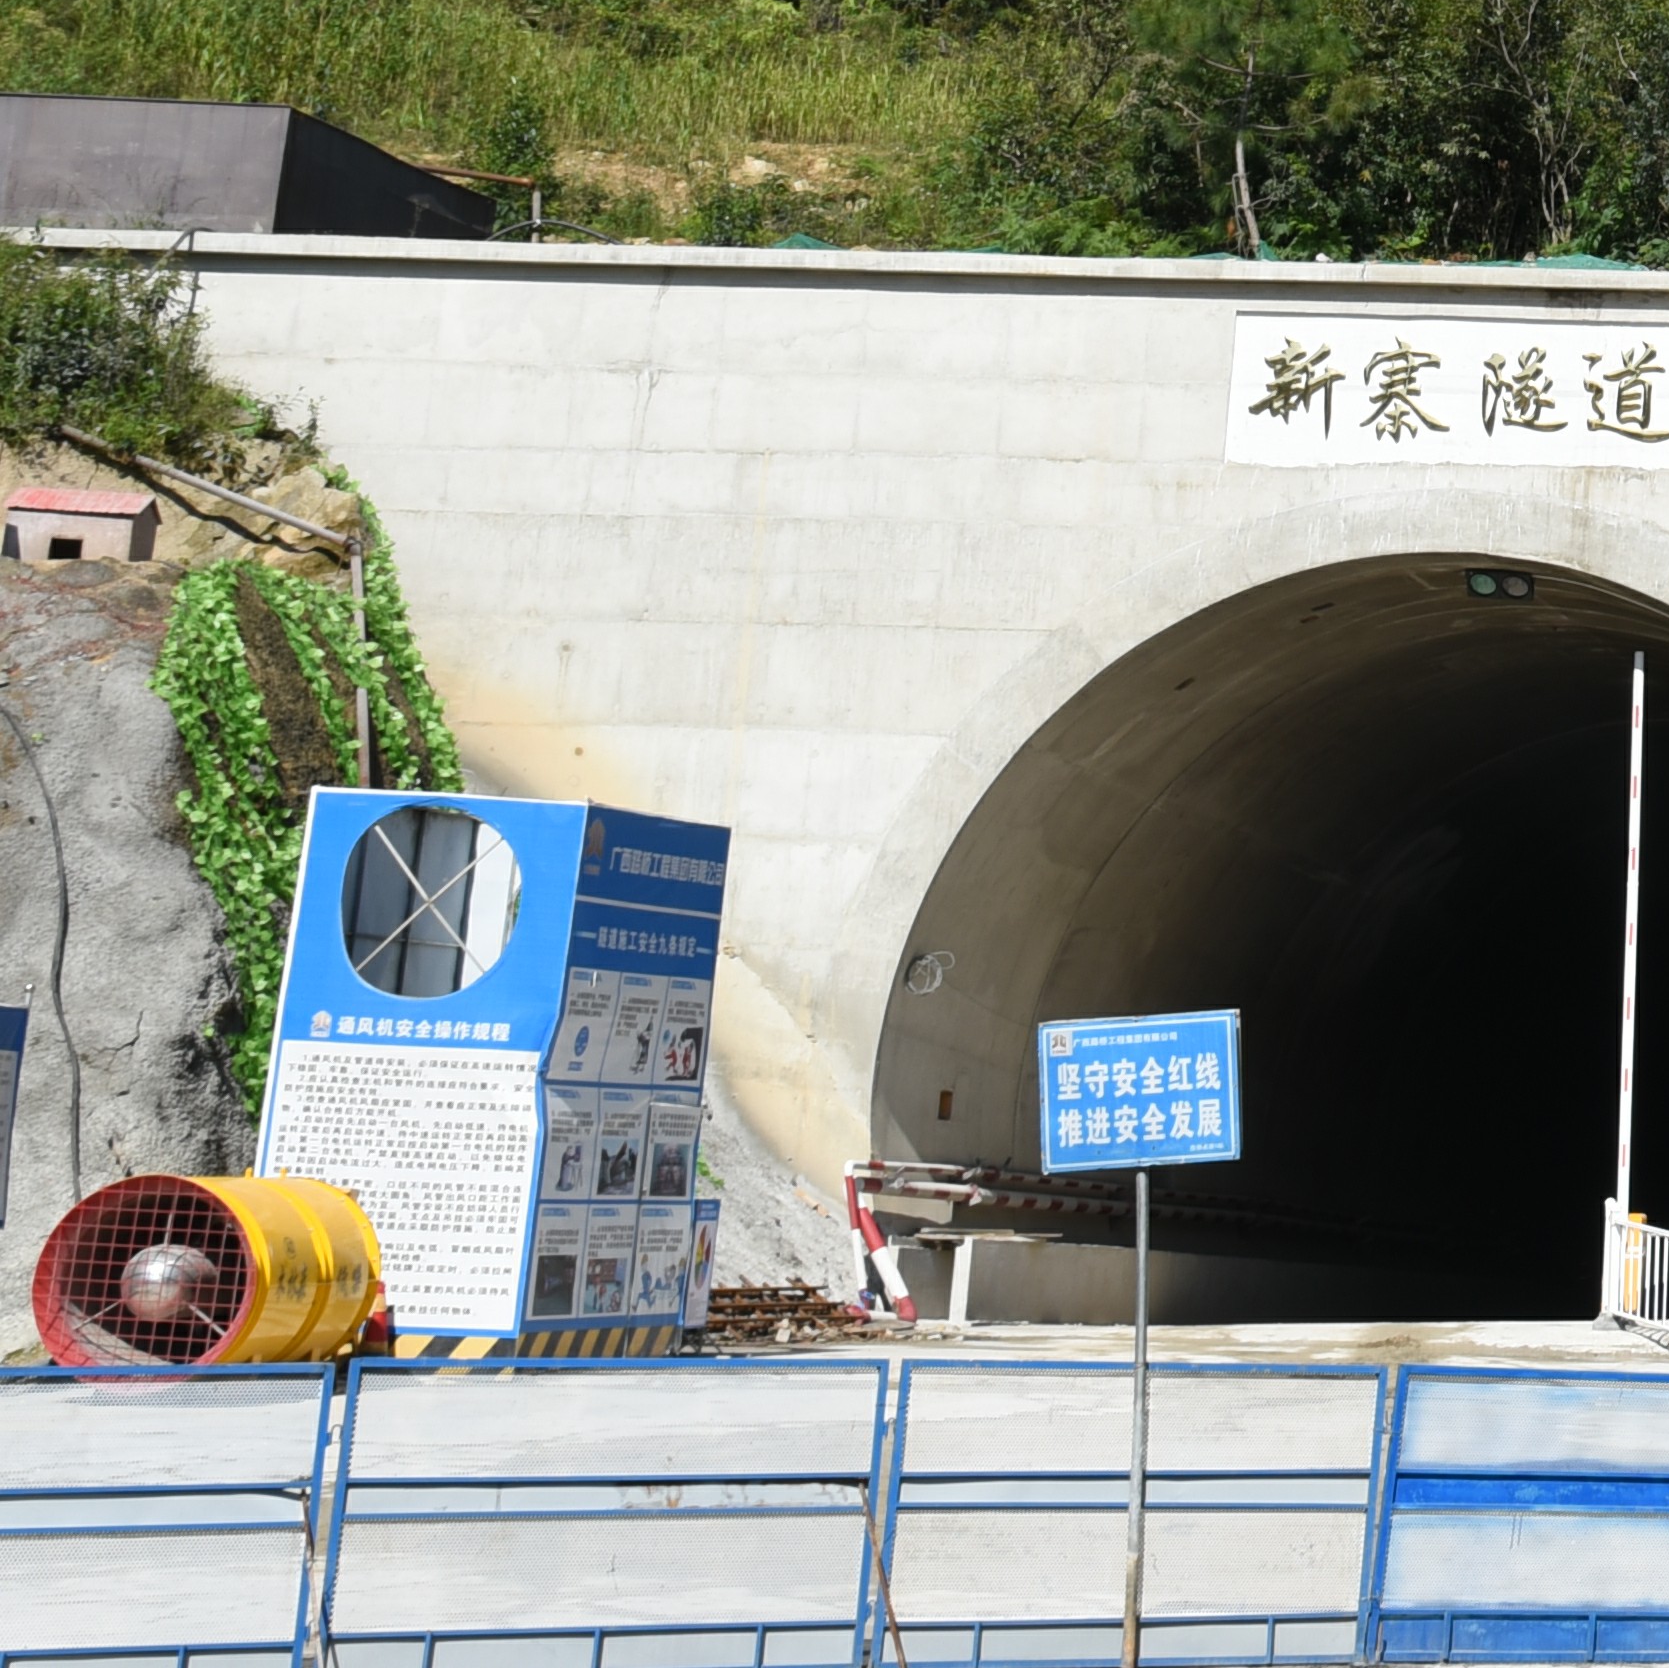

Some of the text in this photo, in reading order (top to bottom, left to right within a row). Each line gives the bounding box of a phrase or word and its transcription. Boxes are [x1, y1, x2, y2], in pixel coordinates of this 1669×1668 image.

[337, 1015, 511, 1042] 通风机安全操作规程
[1073, 1031, 1177, 1048] 广西路桥工程集团有限公司
[1057, 1052, 1221, 1101] 坚守安全红线
[1057, 1099, 1223, 1148] 推进安全发展
